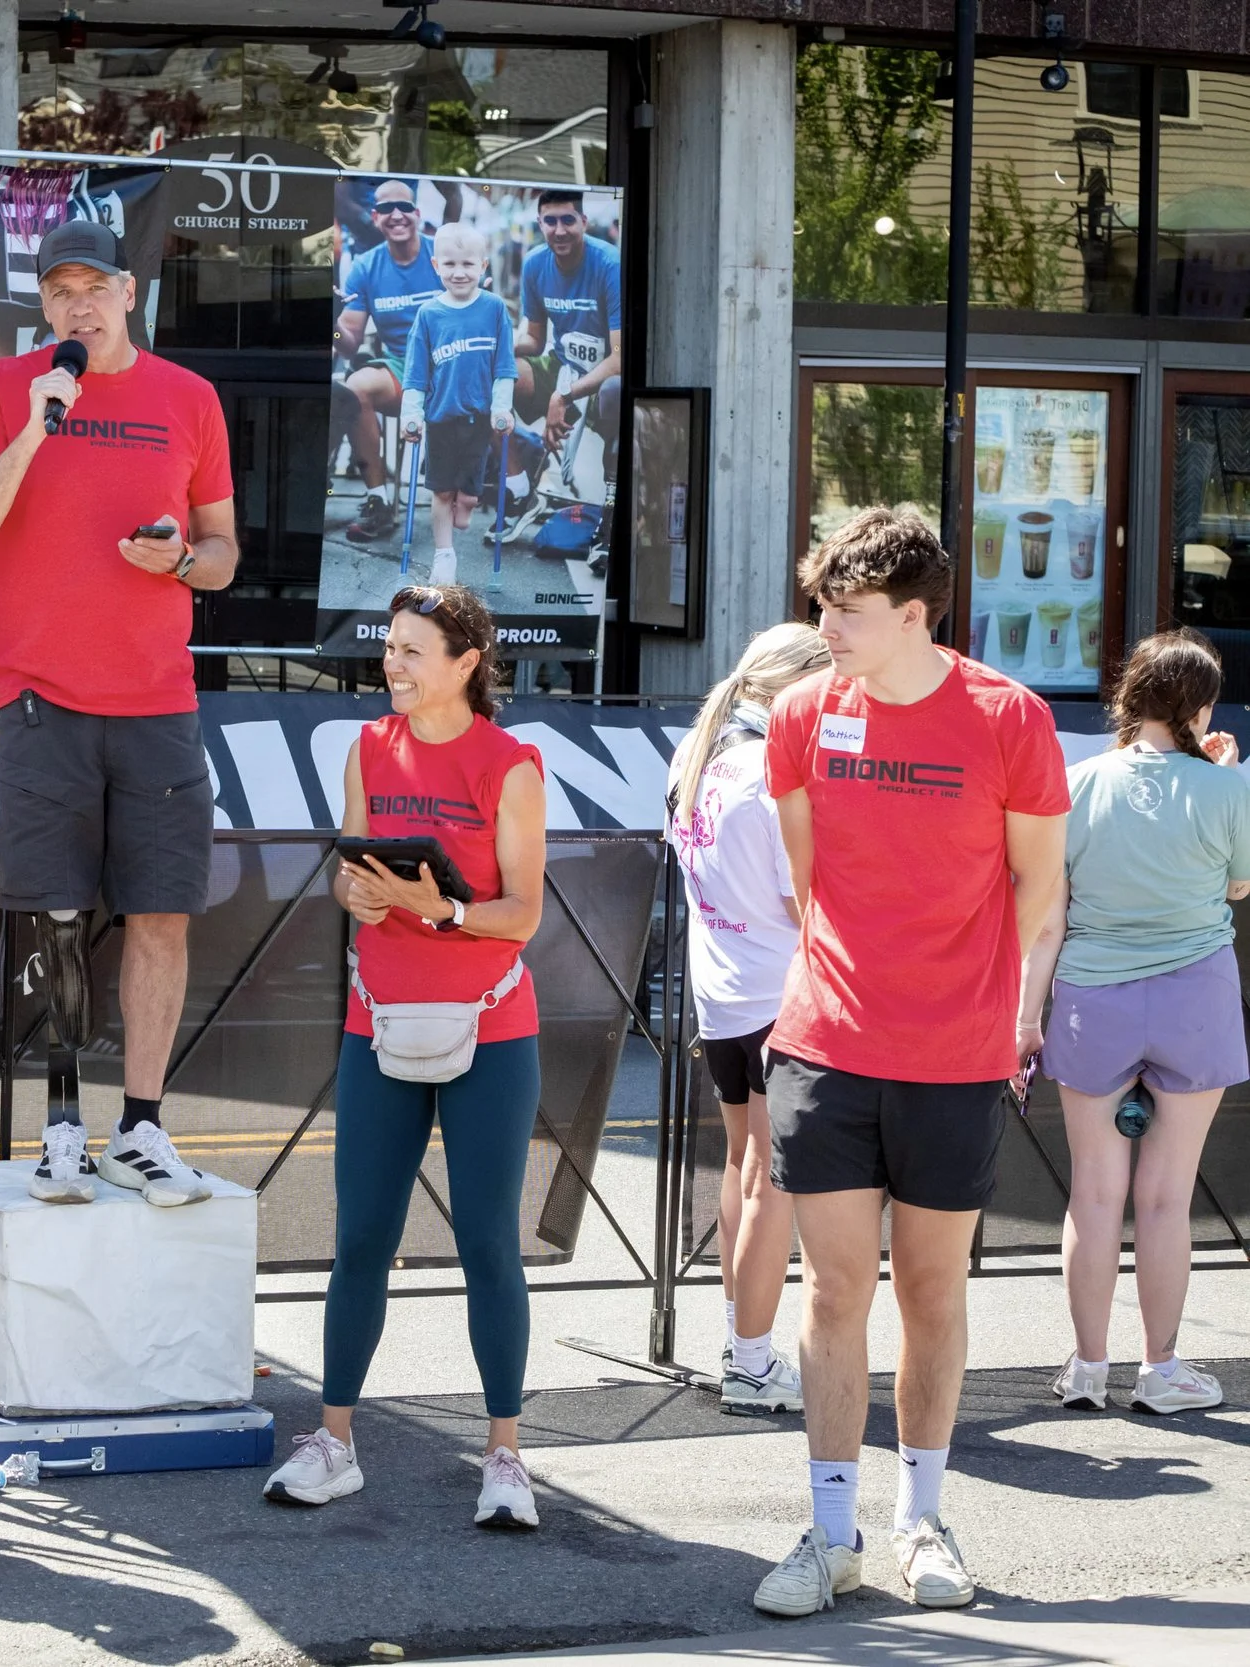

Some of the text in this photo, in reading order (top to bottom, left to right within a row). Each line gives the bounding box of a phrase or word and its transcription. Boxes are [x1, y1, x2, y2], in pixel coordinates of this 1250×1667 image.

[197, 151, 281, 214] 50
[174, 215, 308, 230] CHURCH STREET
[431, 336, 497, 365] BIONIC
[569, 342, 597, 363] 588
[53, 418, 168, 445] IONIC
[534, 593, 594, 605] BIONIC
[496, 628, 561, 643] PROUD.
[821, 727, 861, 741] Matthew
[828, 757, 964, 788] BIONIC
[877, 784, 962, 799] PROJECT INC
[369, 795, 486, 825] BIONIC
